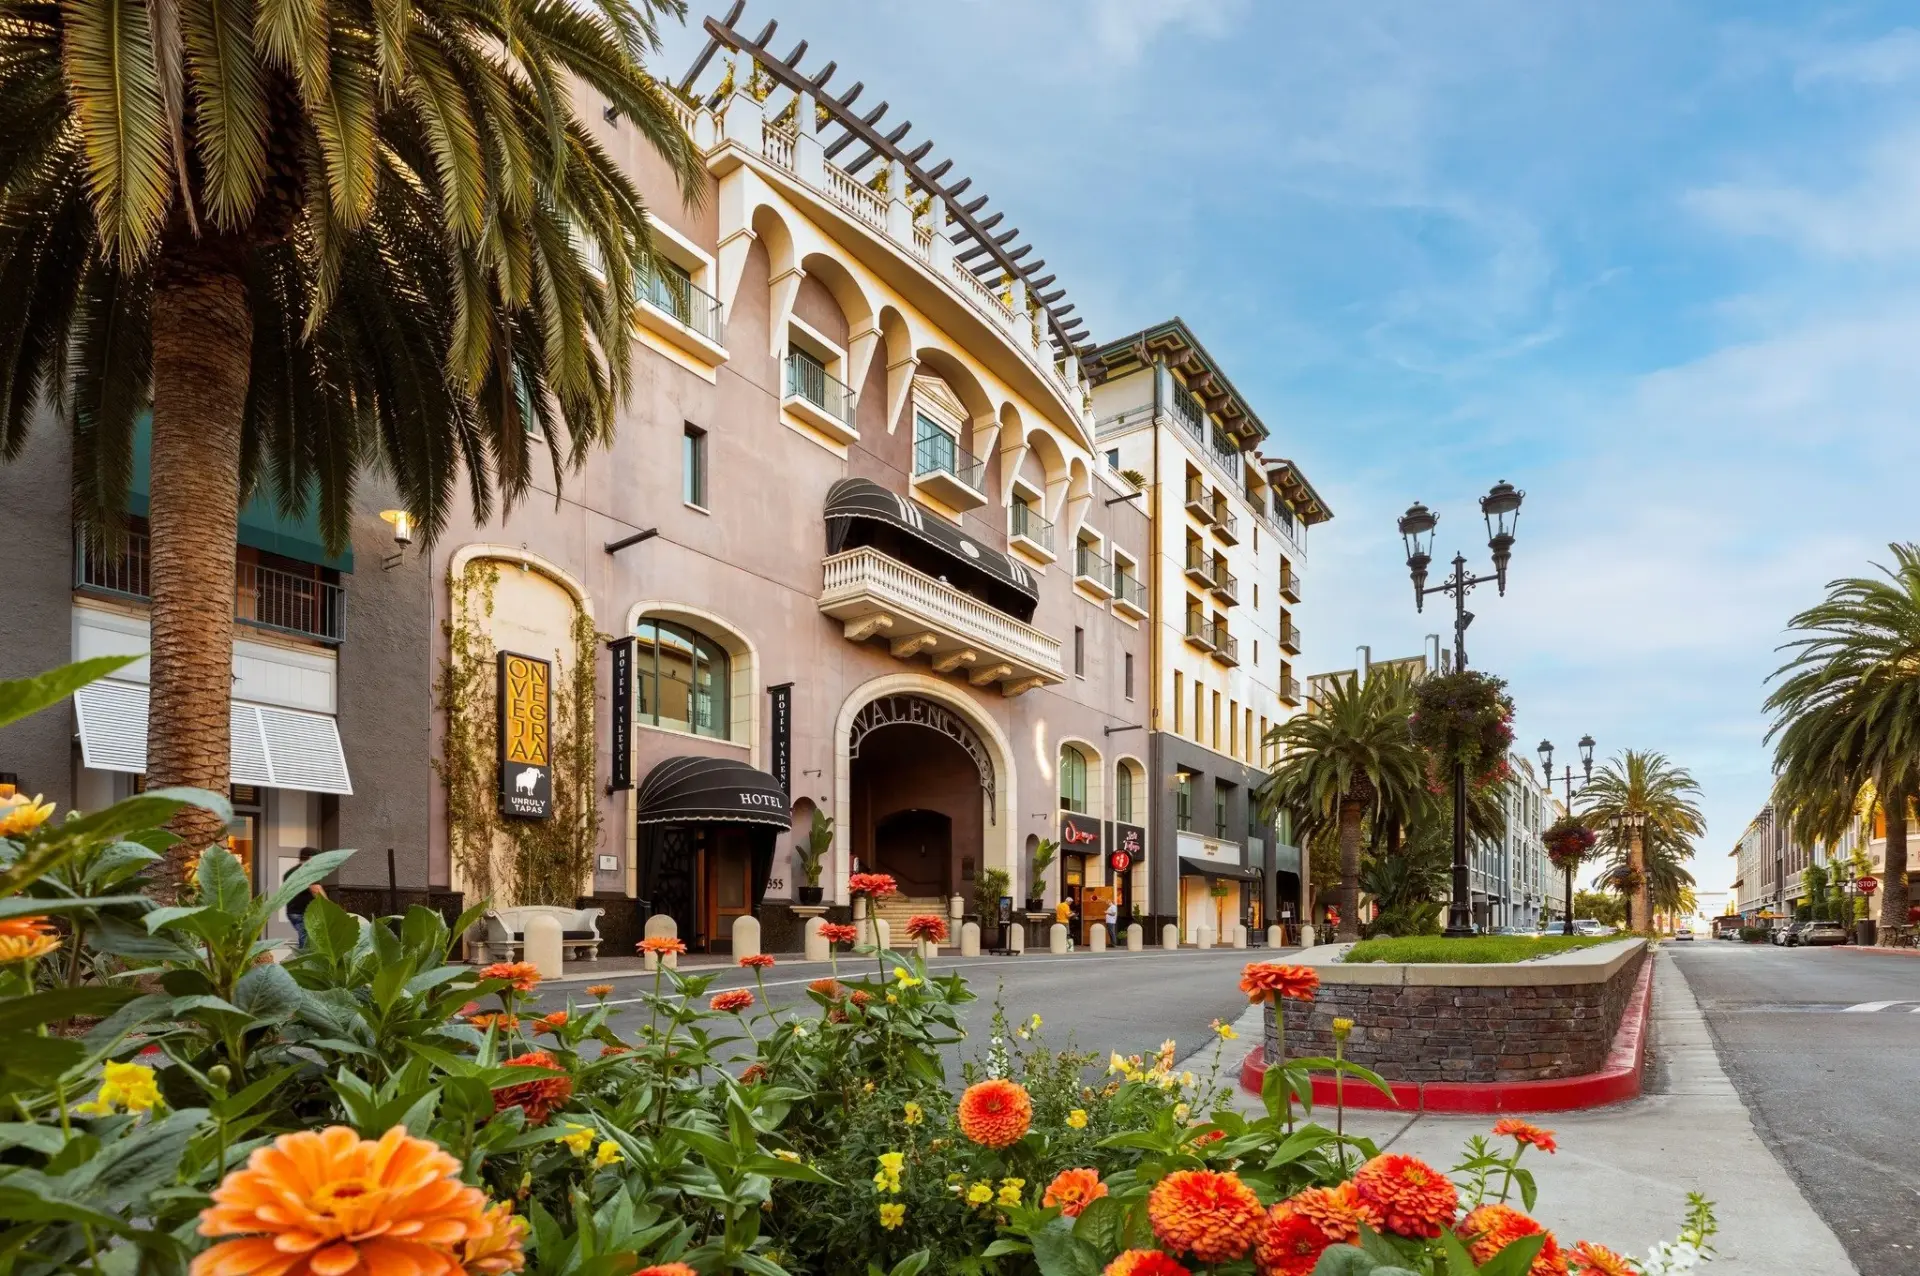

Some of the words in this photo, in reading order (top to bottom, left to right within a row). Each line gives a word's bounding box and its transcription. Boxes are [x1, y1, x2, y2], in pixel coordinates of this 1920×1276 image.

[854, 695, 981, 762] VALENCIA
[511, 797, 546, 807] UNRULY
[739, 793, 783, 809] HOTEL
[514, 804, 543, 814] TAPAS
[767, 878, 784, 890] 355
